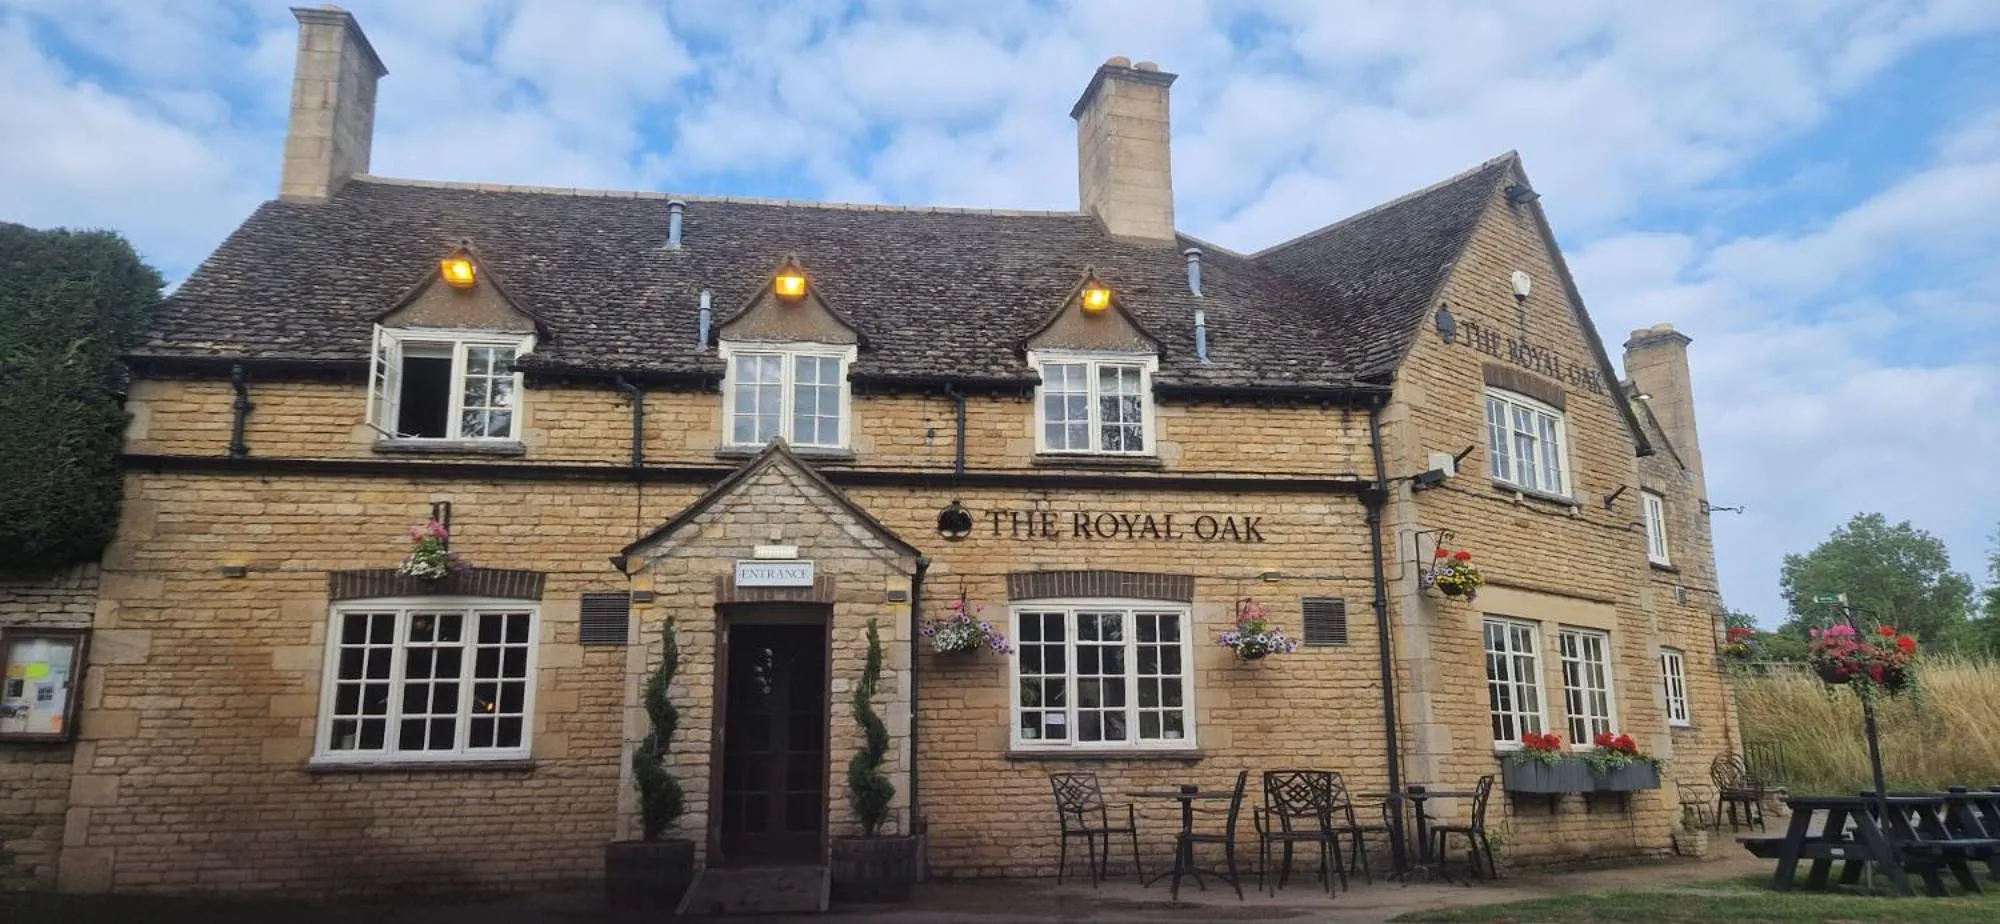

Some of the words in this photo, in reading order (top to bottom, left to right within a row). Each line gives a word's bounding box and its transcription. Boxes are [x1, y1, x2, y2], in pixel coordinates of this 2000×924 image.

[1460, 320, 1502, 359] THE
[1506, 338, 1565, 383] ROYAL
[1567, 363, 1606, 395] OAK
[984, 510, 1060, 538] THE
[1072, 511, 1184, 540] ROYAL
[1194, 515, 1267, 542] OAK
[741, 567, 809, 579] ENTRANCE
